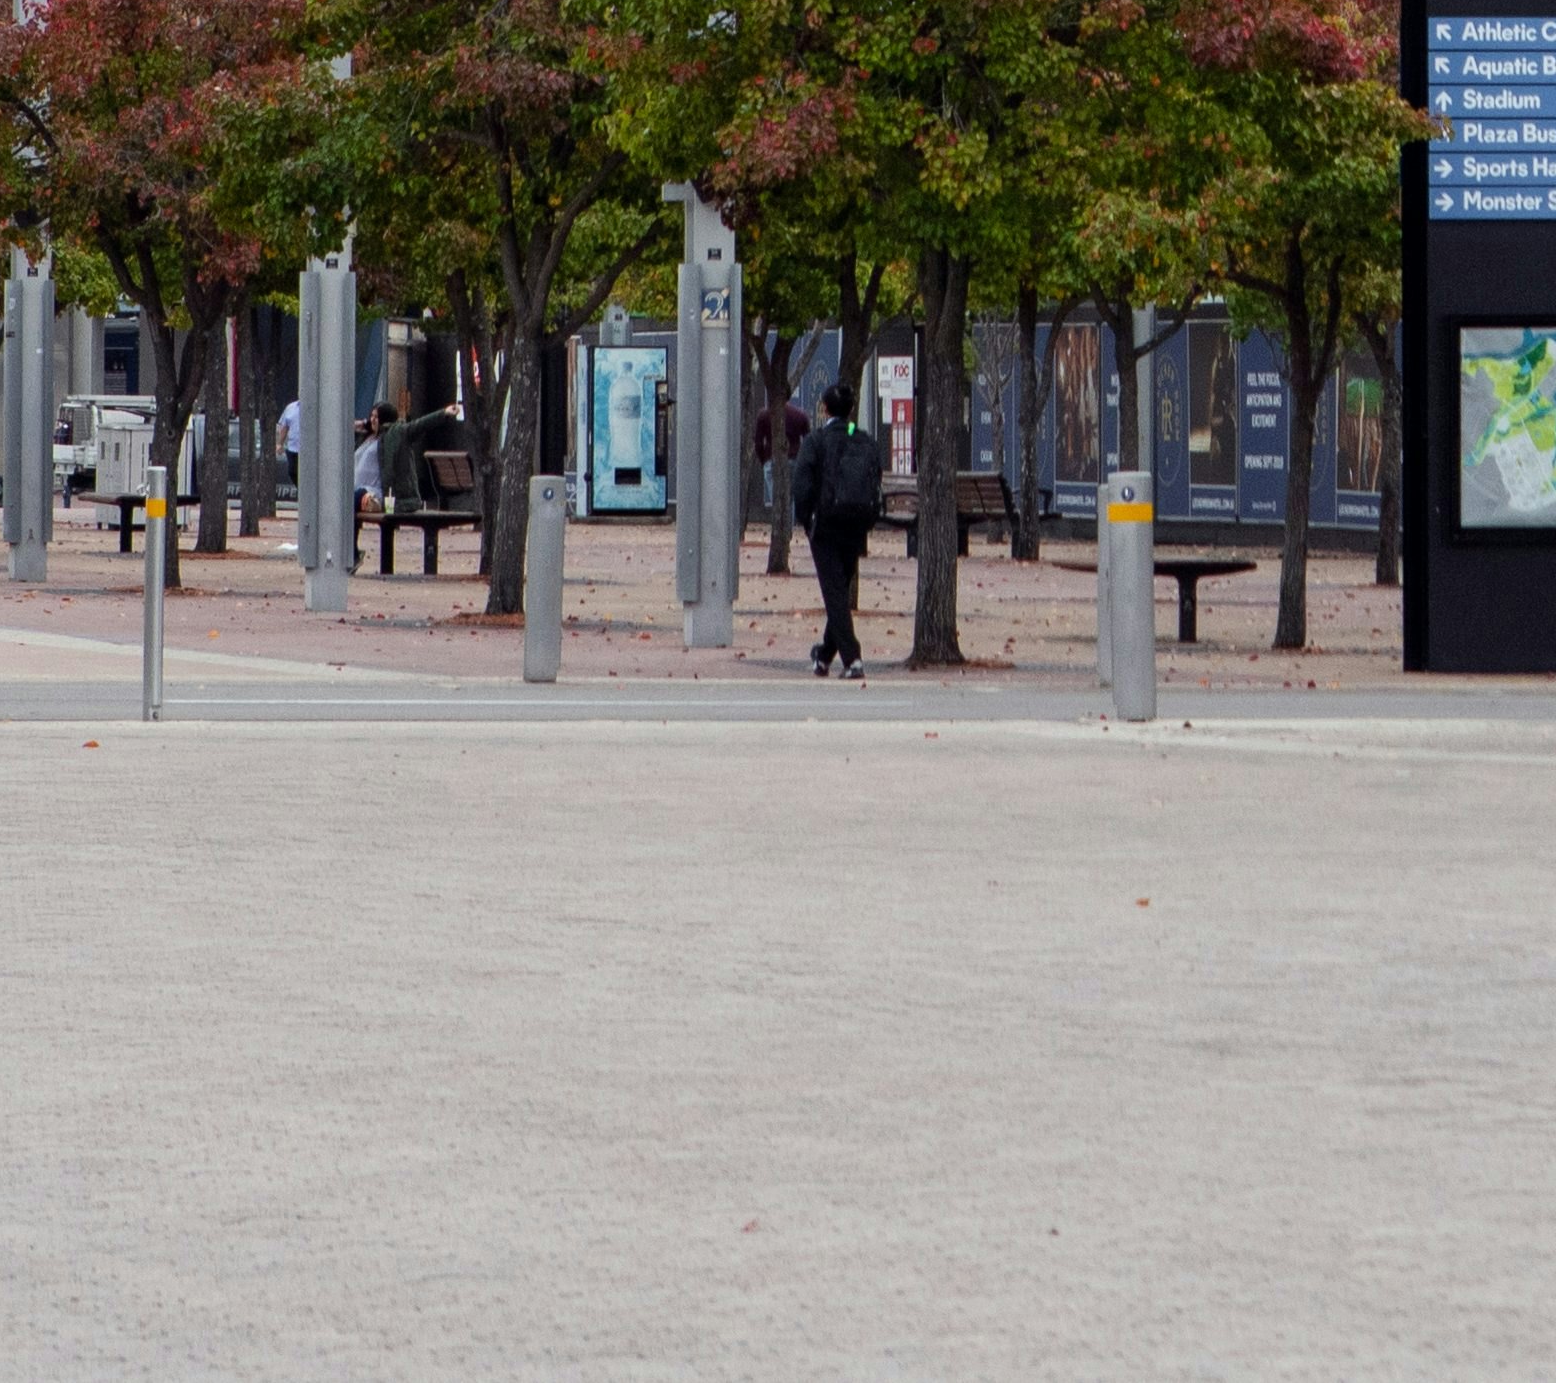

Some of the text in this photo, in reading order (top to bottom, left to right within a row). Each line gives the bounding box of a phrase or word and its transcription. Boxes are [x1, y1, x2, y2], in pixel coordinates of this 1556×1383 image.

[1462, 21, 1537, 41] Athletic
[1462, 55, 1538, 79] Aquatic
[1463, 88, 1541, 109] Stadium
[1463, 122, 1518, 143] Plaza
[1463, 156, 1528, 181] Sports
[1463, 190, 1542, 210] Monster
